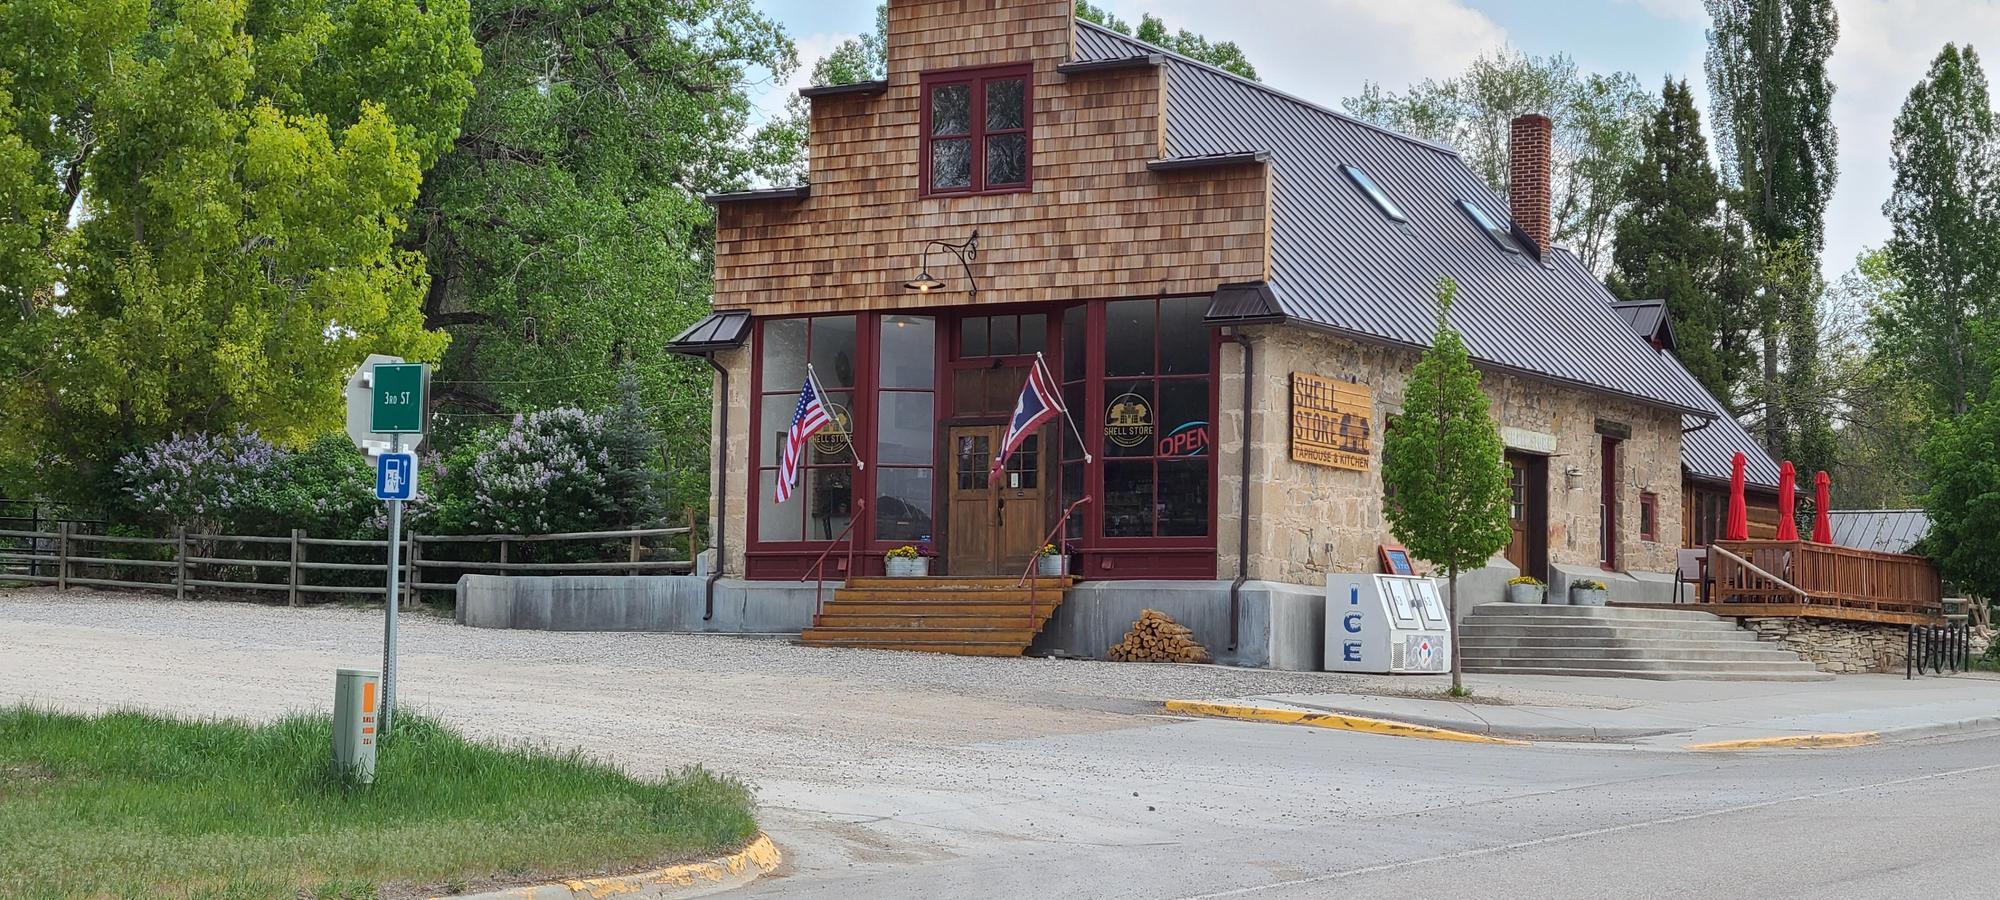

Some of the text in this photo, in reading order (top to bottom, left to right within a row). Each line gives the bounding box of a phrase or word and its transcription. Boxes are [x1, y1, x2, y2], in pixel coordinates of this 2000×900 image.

[384, 391, 410, 405] 3RD ST
[1296, 377, 1338, 411] SHELL
[812, 434, 829, 443] HELL
[1104, 426, 1153, 436] SHELL STORE
[1296, 411, 1337, 444] STORE
[1160, 427, 1209, 456] OPEN
[1295, 446, 1369, 469] TAPHOUSE & KITCHEN
[1343, 583, 1363, 662] ICE
